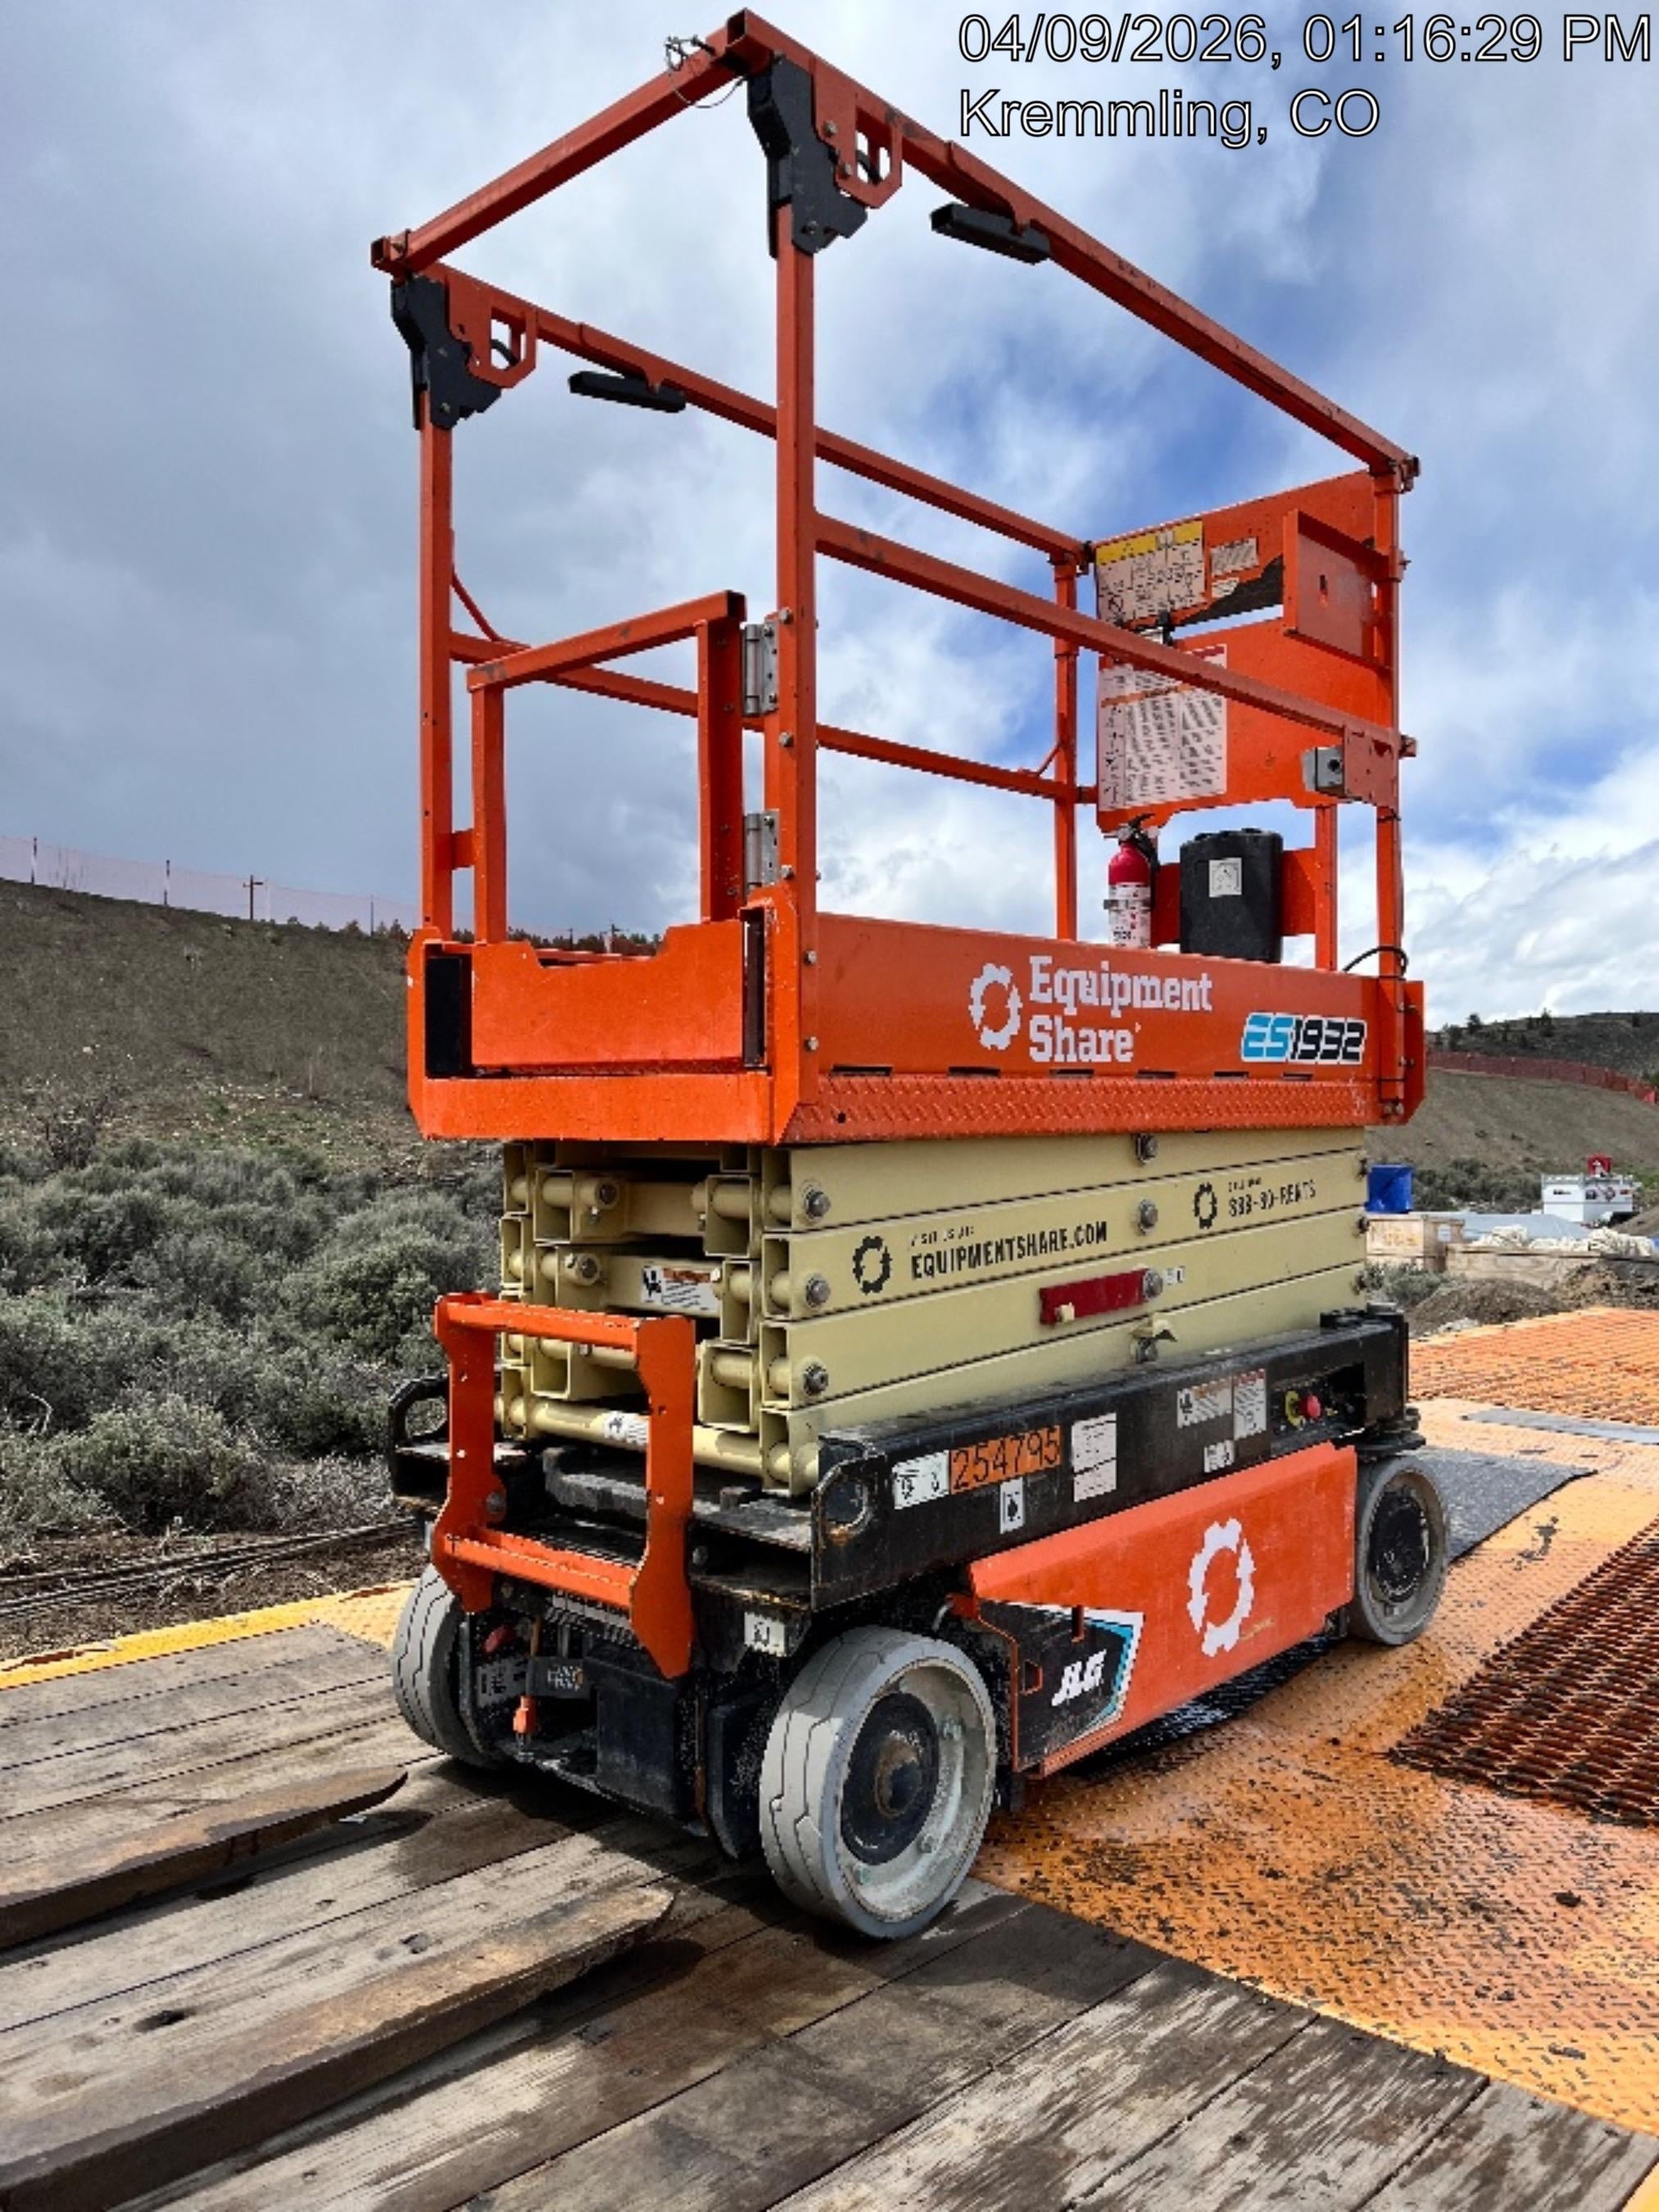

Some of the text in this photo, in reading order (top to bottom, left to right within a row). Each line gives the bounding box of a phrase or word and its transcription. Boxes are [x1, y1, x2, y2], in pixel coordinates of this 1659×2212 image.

[1029, 955, 1213, 1018] Equipment
[1029, 1014, 1134, 1063] Share
[1241, 1012, 1367, 1065] ES1932
[911, 1221, 1108, 1280] EQUIPMENTSHARE.COM
[953, 1428, 1061, 1490] 254795
[1051, 1648, 1107, 1707] JLG
